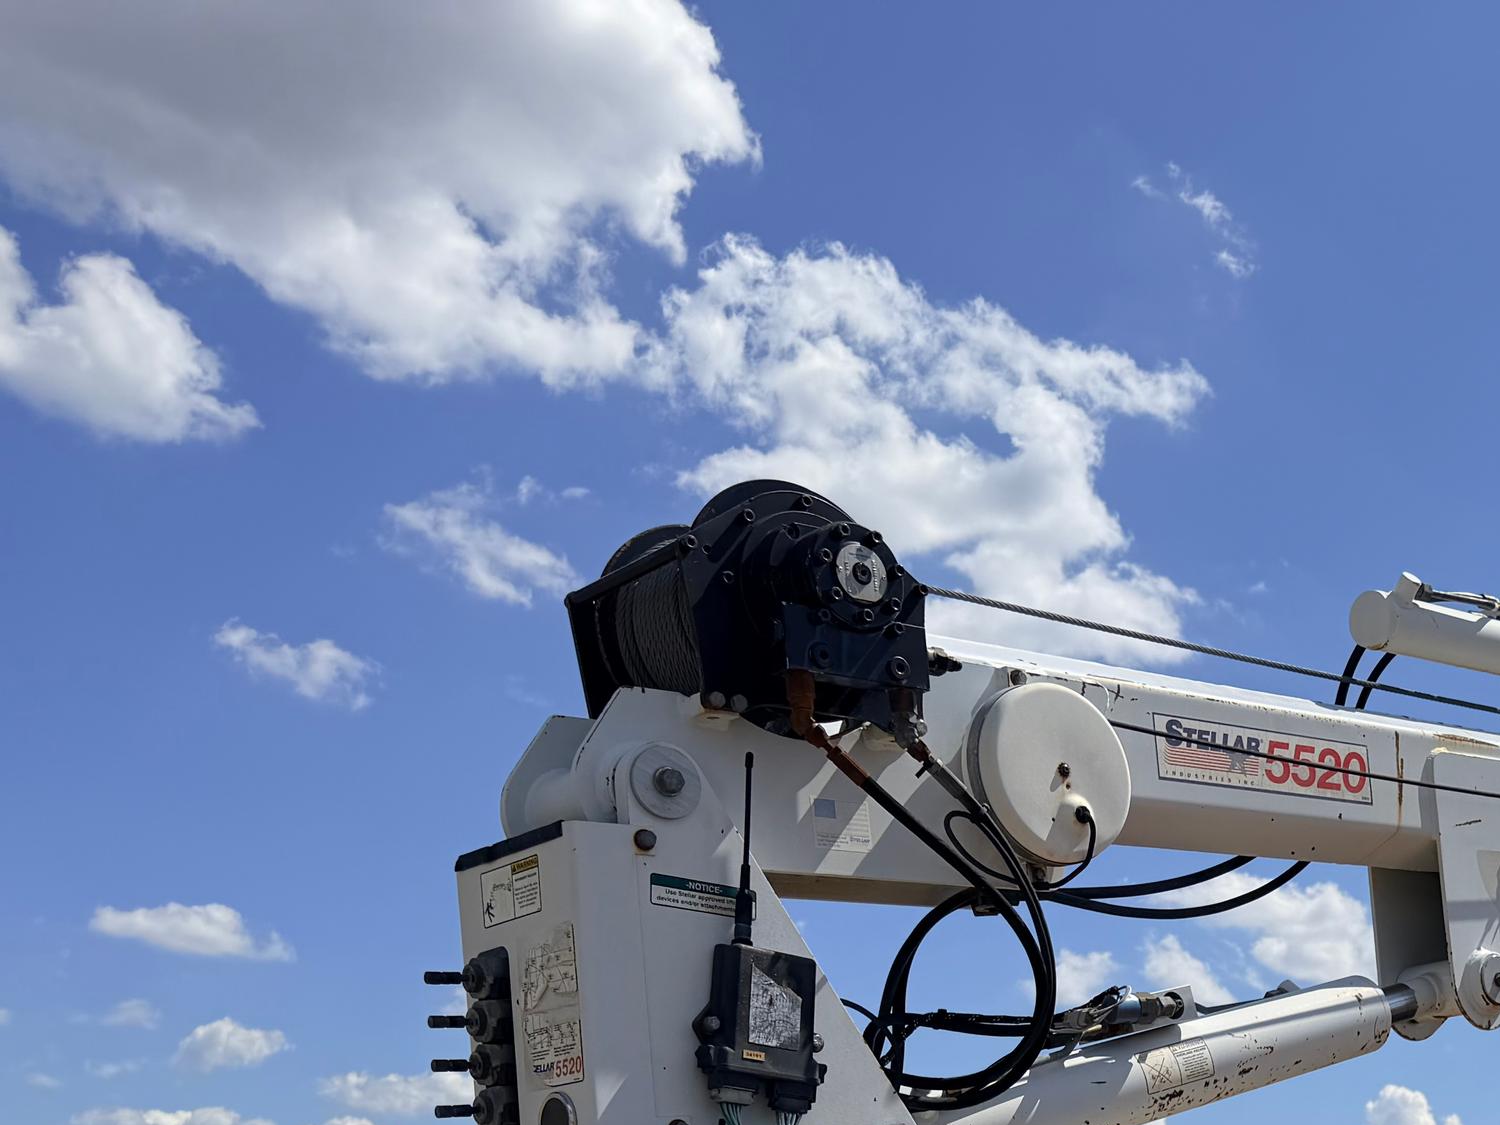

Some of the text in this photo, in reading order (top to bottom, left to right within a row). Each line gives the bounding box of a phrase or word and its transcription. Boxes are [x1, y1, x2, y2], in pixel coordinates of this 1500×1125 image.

[1165, 718, 1262, 753] STELLAR
[1165, 769, 1232, 783] INDUSTRIES
[1264, 740, 1367, 794] 5520
[555, 1055, 582, 1078] 5520
